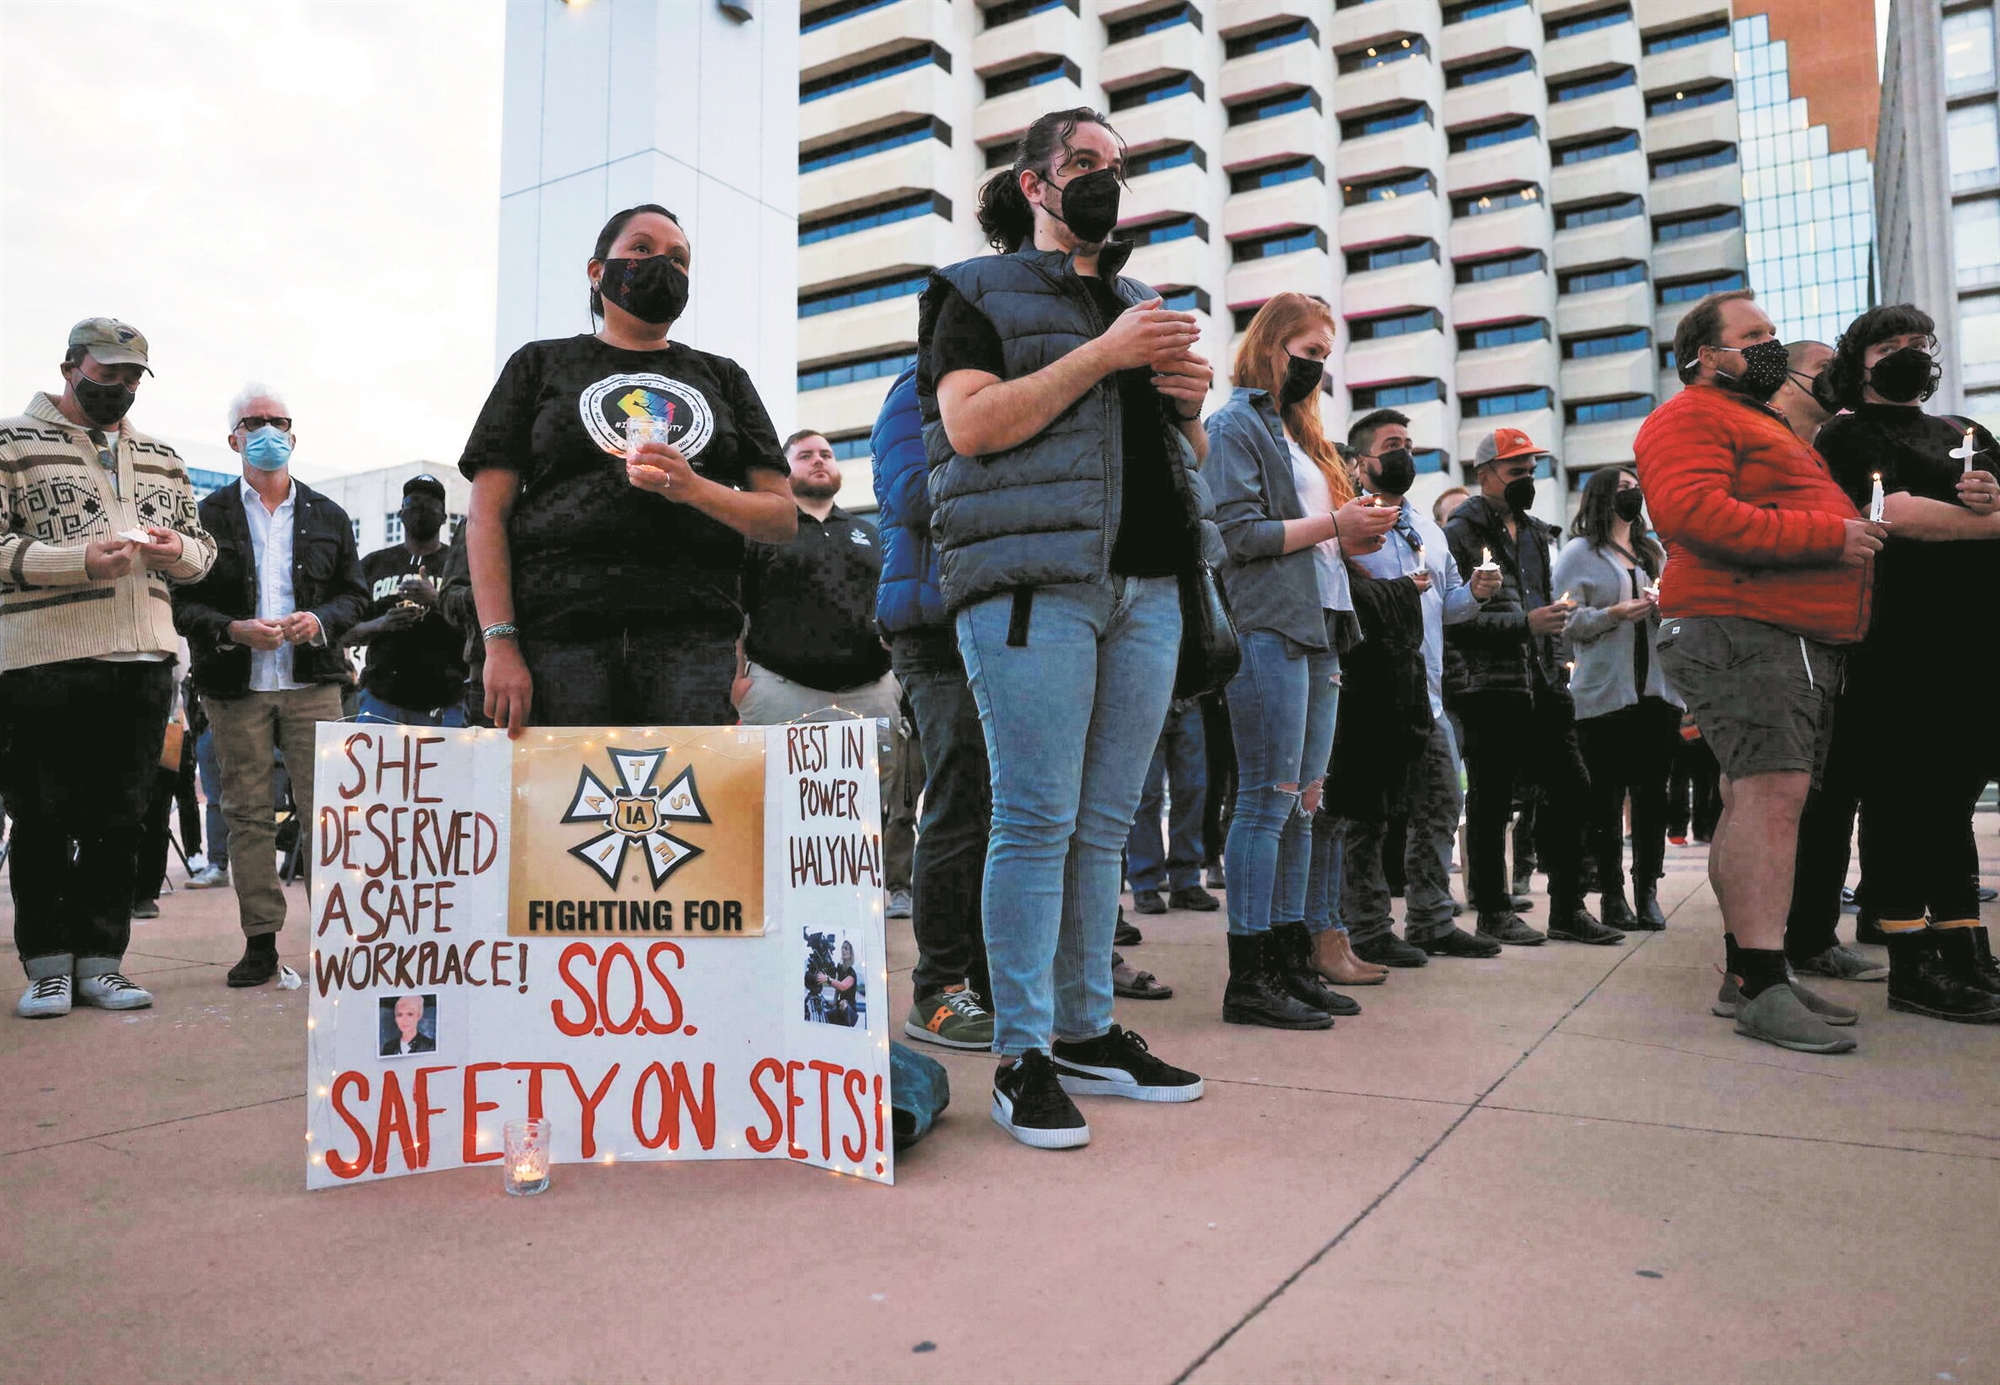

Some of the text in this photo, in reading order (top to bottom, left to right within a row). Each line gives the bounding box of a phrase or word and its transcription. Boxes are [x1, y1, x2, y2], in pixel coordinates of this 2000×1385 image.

[338, 732, 446, 804] SHE
[787, 725, 865, 775] REST IN
[626, 806, 646, 825] IA
[799, 777, 860, 821] POWER
[320, 803, 498, 880] DESERVED
[790, 833, 882, 888] HALYNA!
[317, 879, 456, 943] A SAFE
[529, 900, 743, 931] FIGHTING FOR
[314, 939, 529, 998] WORKPLACE!
[551, 941, 698, 1037] S.O.S.
[325, 1057, 884, 1179] SAFETY ON SETS!
